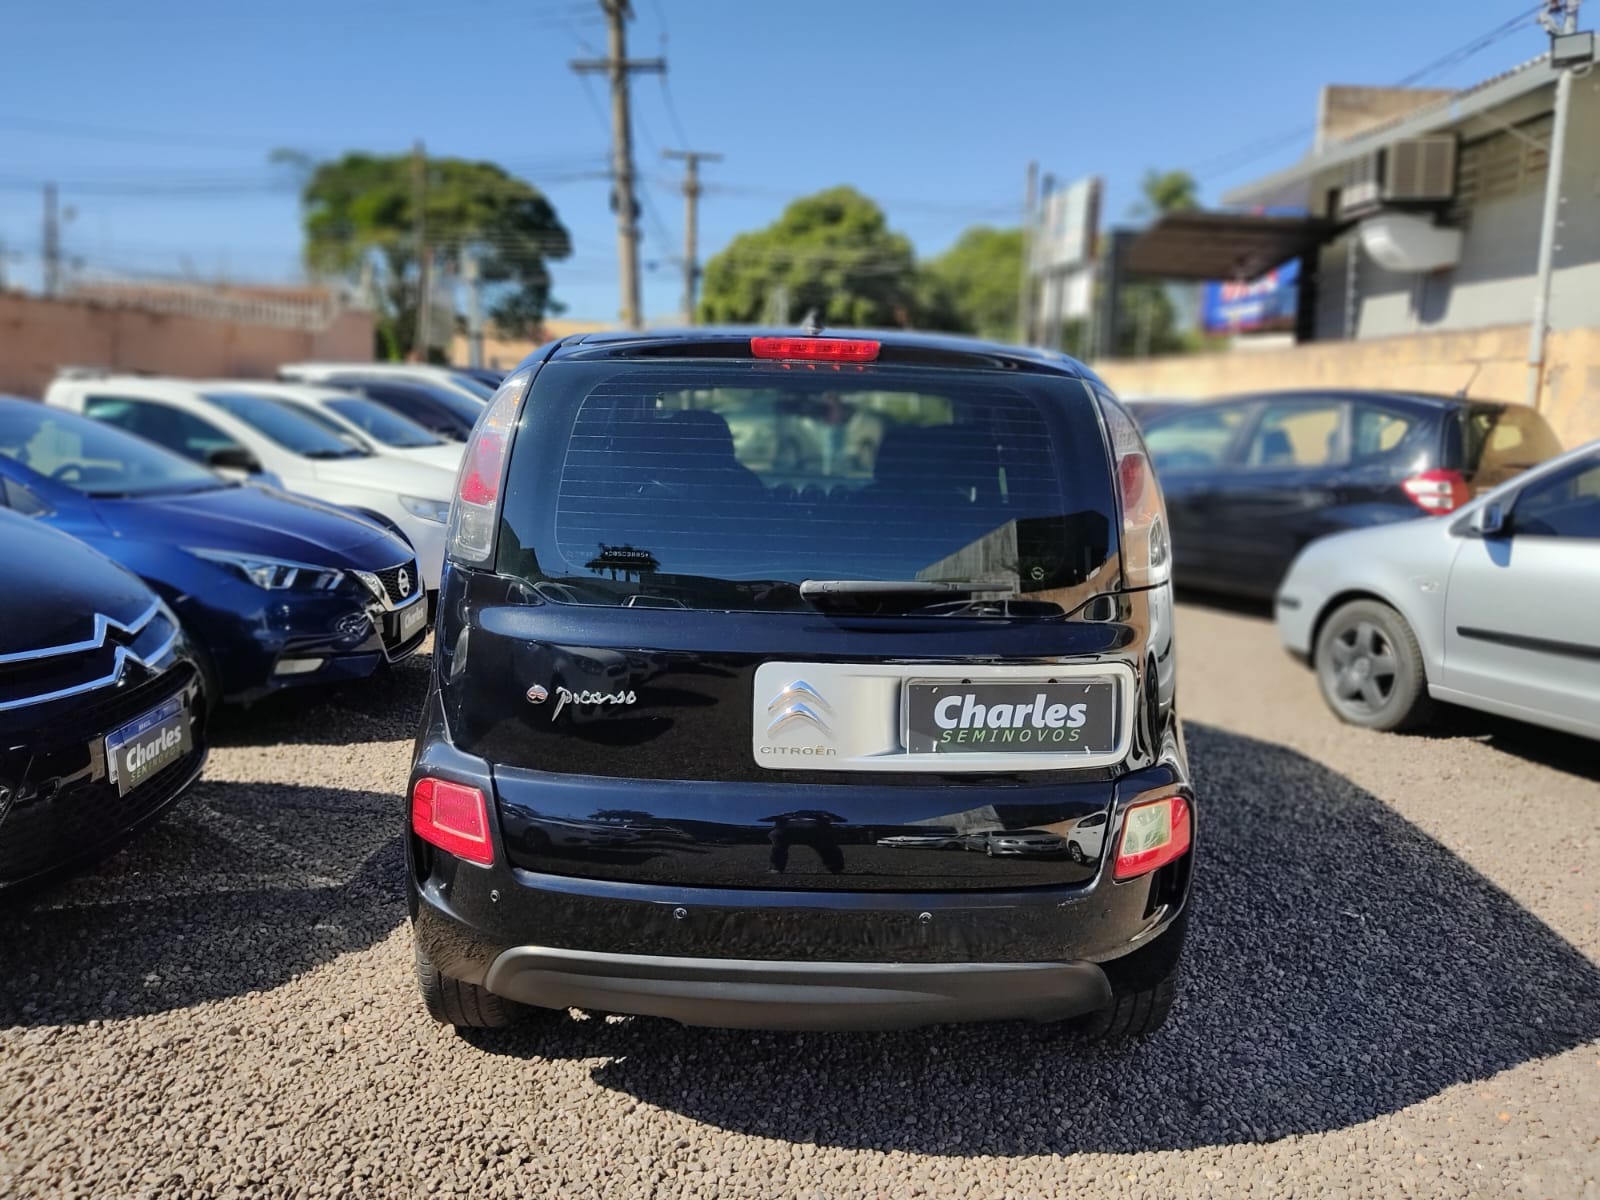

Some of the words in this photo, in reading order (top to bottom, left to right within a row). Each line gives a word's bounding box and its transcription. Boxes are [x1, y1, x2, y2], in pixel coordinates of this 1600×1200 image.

[933, 694, 1087, 729] Charles
[126, 725, 182, 772] Charles
[940, 729, 1082, 744] SEMINOVOS
